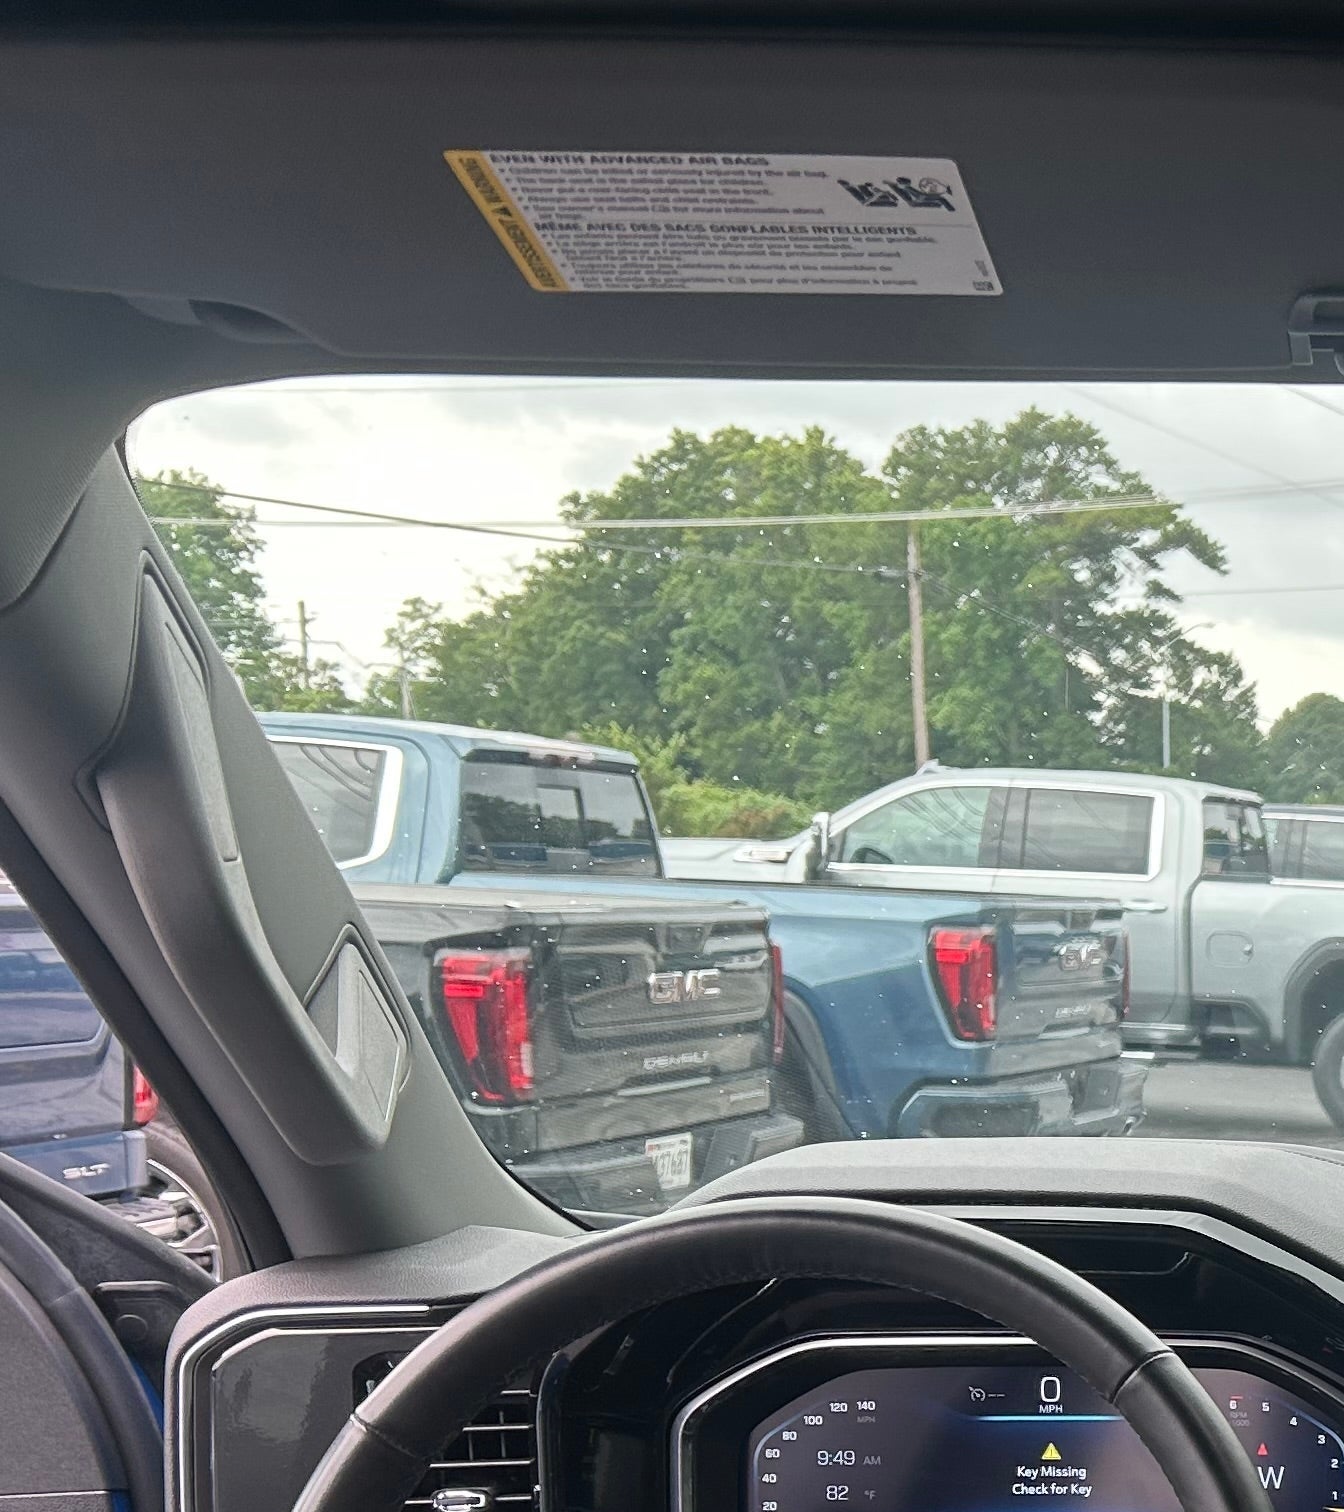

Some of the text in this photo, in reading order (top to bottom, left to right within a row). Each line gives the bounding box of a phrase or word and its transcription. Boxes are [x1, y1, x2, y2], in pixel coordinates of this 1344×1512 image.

[490, 154, 769, 166] EVEN WITH ADVANCED AIR BAGS
[664, 224, 706, 232] SACS
[812, 226, 918, 235] INTELLIGENTS
[62, 1163, 110, 1180] SLT
[1040, 1376, 1061, 1402] 0
[829, 1402, 848, 1412] 120
[856, 1401, 876, 1411] 140
[1039, 1405, 1063, 1414] MPH
[1262, 1402, 1270, 1411] 5
[803, 1415, 823, 1425] 100
[1289, 1416, 1298, 1426] 4
[782, 1431, 797, 1440] 80
[1317, 1434, 1326, 1444] 3
[765, 1449, 780, 1458] 60
[817, 1450, 856, 1466] 9:49
[863, 1455, 881, 1465] AM
[1331, 1459, 1339, 1469] 2
[762, 1473, 777, 1483] 40
[1017, 1466, 1087, 1480] Key Missing
[826, 1485, 849, 1501] 82
[1012, 1483, 1093, 1498] Check for Key
[1332, 1491, 1338, 1500] 1
[762, 1501, 777, 1511] 20
